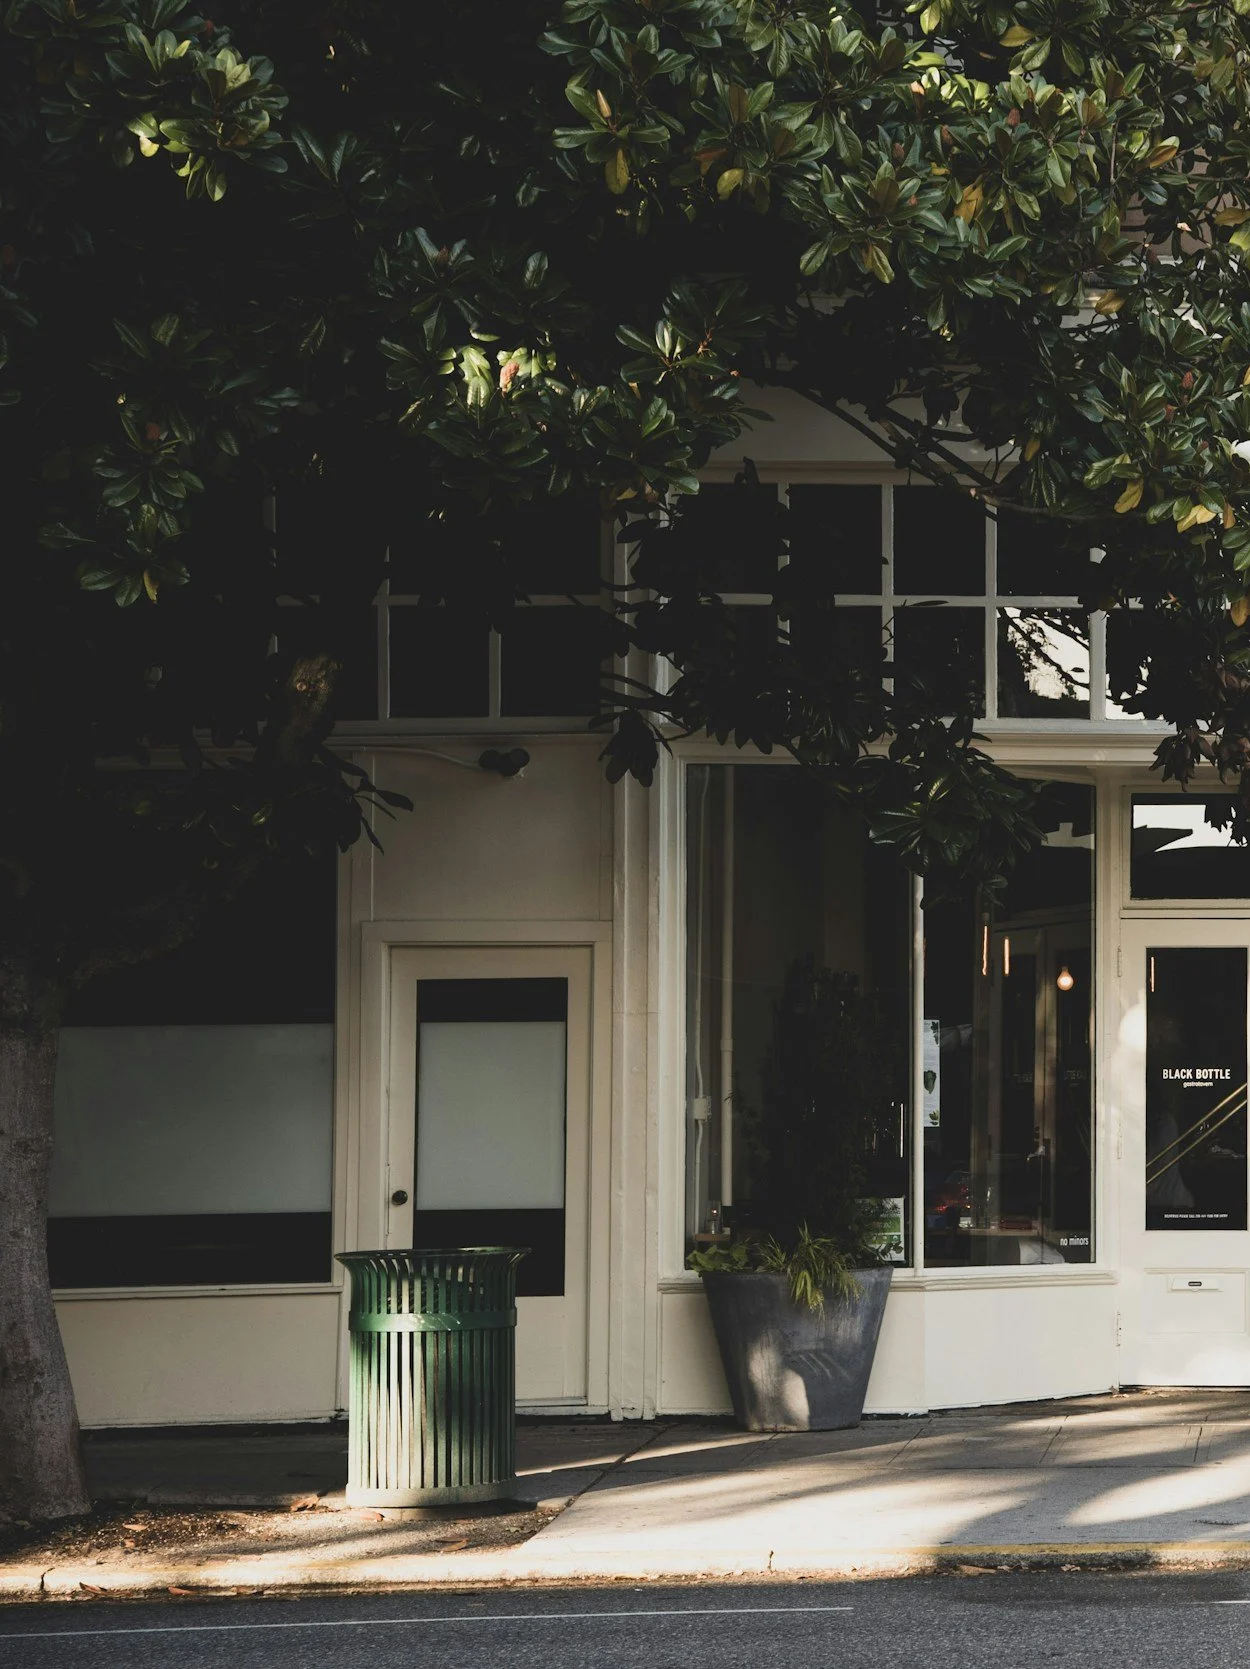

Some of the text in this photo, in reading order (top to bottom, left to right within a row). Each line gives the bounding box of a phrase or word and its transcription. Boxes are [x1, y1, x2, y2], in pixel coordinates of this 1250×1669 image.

[1162, 1068, 1231, 1080] BLACK BOTTLE
[1182, 1081, 1214, 1089] gastrotavern
[1059, 1235, 1089, 1246] no minors
